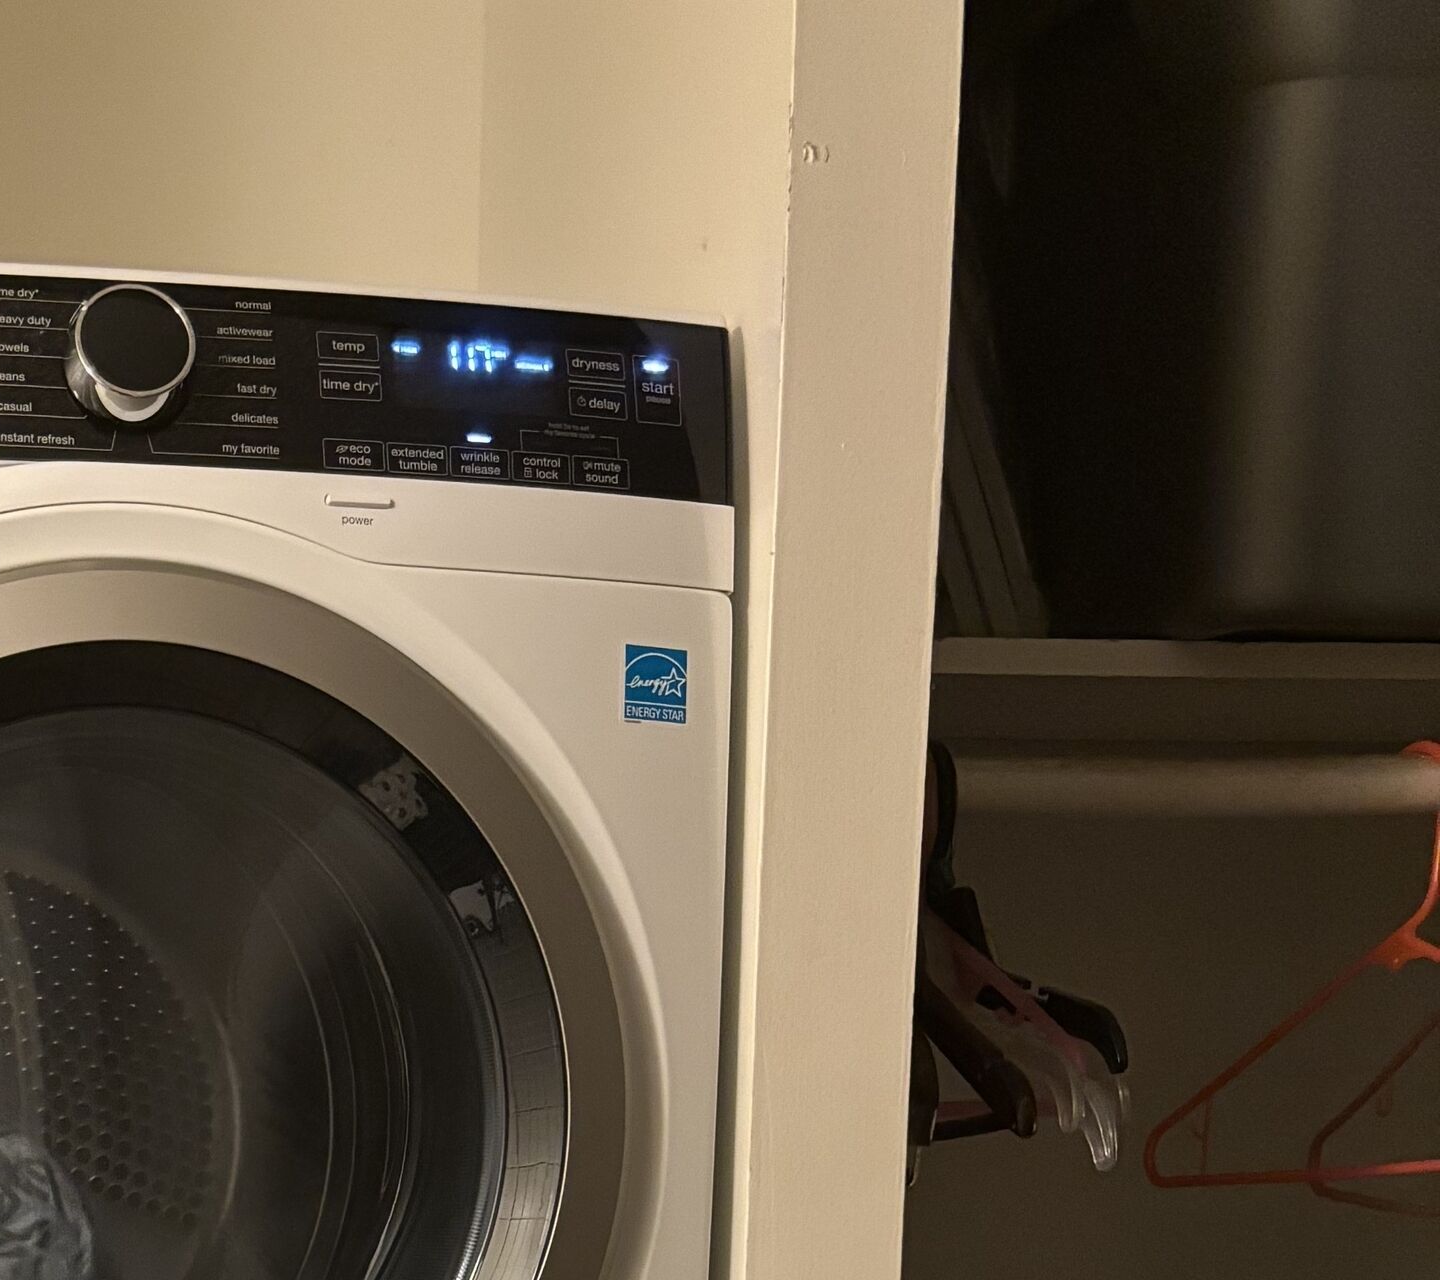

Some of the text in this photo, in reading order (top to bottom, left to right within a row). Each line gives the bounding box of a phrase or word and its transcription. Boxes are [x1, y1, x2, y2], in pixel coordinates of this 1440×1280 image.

[235, 300, 271, 311] normal
[27, 315, 51, 327] duty
[216, 326, 273, 337] activewear
[332, 340, 365, 356] temp
[218, 353, 275, 366] mixed load
[572, 357, 620, 372] dryness
[237, 383, 277, 397] fast dry
[322, 378, 350, 391] time
[641, 381, 675, 396] start
[588, 397, 621, 413] delay
[231, 412, 279, 425] delicates
[37, 433, 75, 445] refresh
[222, 443, 280, 455] my favorite
[349, 444, 371, 456] eco
[391, 447, 444, 461] extended
[338, 454, 372, 467] mode
[460, 451, 500, 464] wrinkle
[523, 456, 560, 468] control
[398, 459, 438, 473] tumble
[460, 463, 501, 477] release
[594, 461, 621, 473] mute
[536, 468, 559, 480] lock
[585, 472, 619, 484] sound
[341, 514, 374, 527] power
[626, 705, 684, 721] ENERGY STAR
